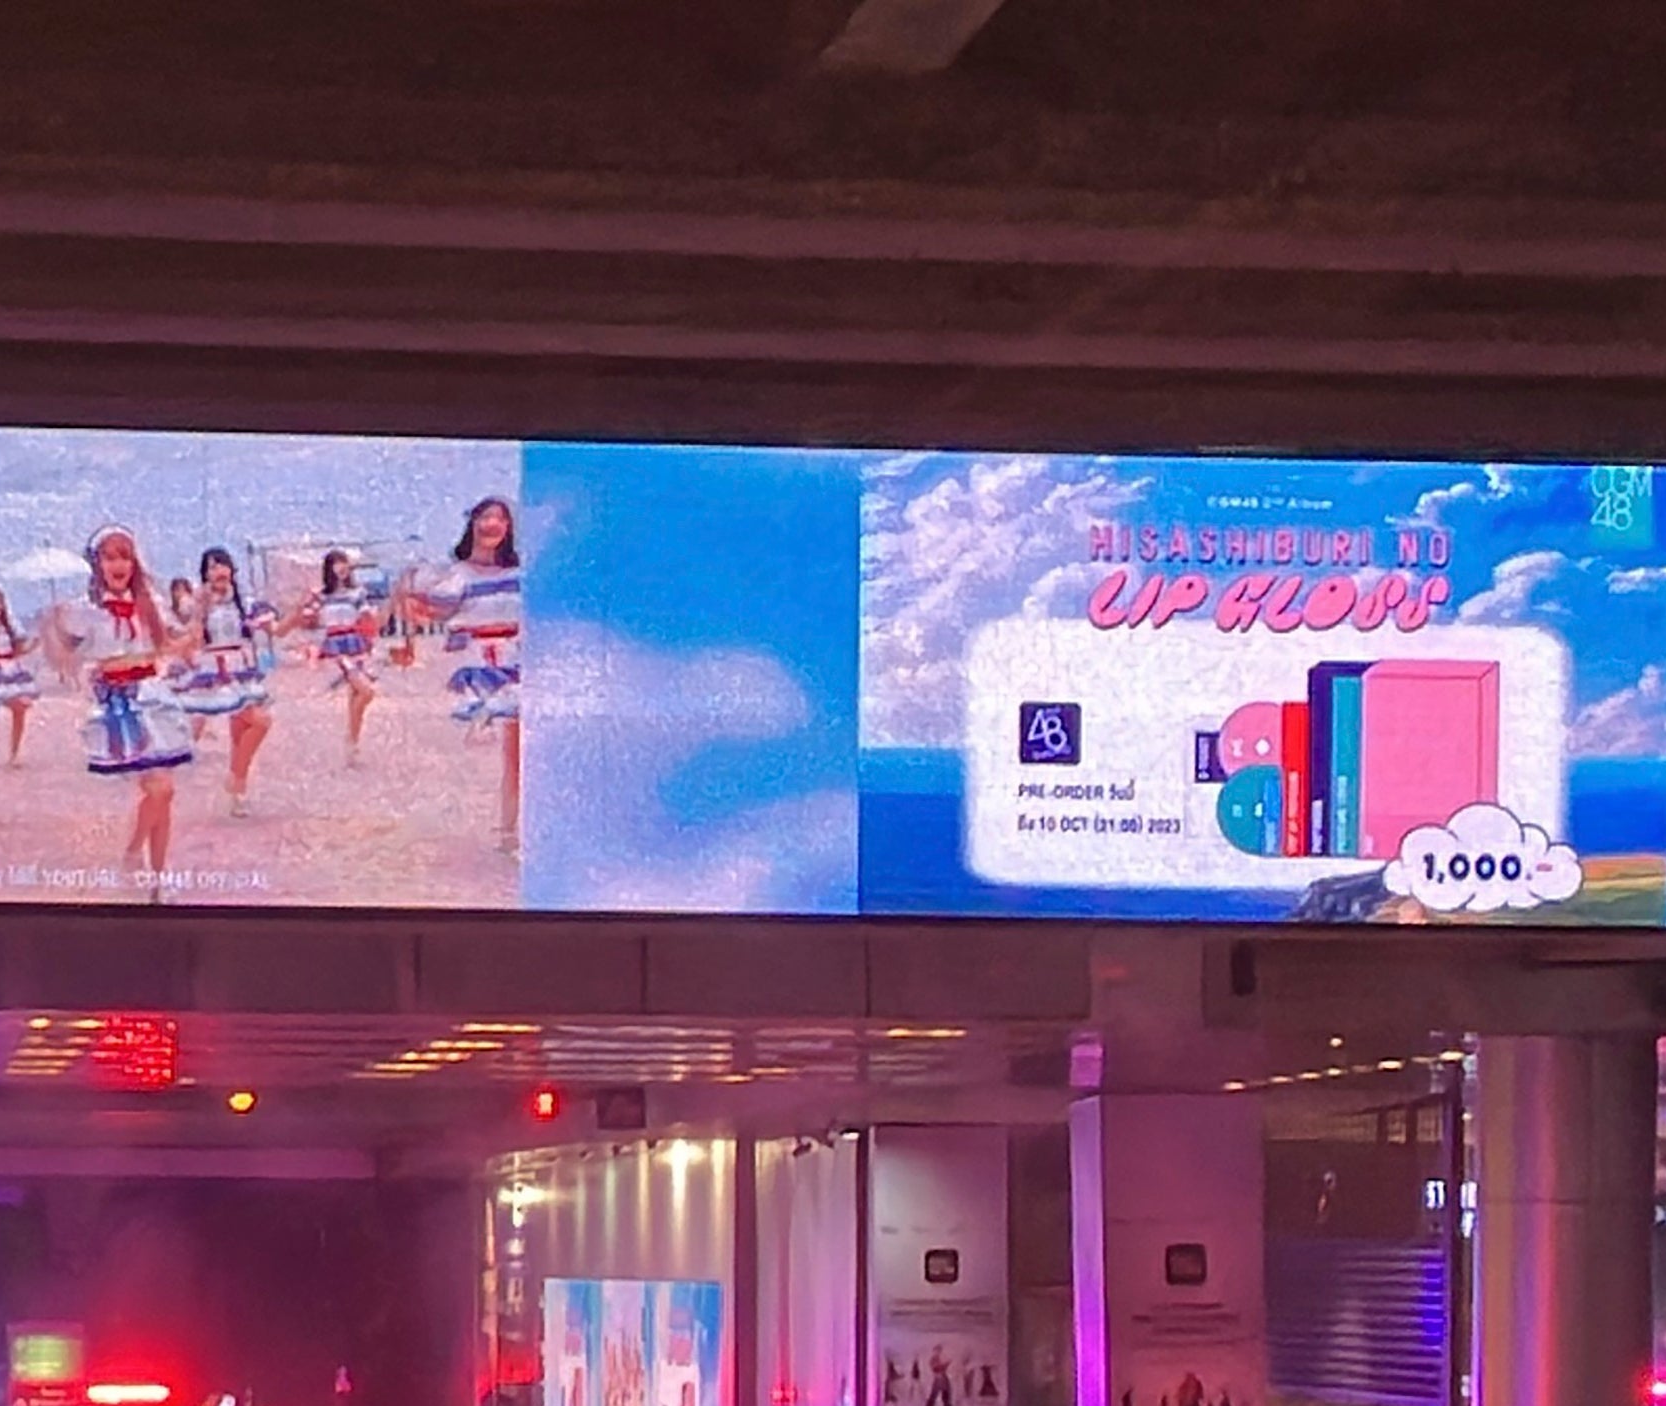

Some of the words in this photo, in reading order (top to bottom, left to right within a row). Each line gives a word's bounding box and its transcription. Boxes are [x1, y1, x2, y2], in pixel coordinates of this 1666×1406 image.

[1590, 495, 1633, 531] 48
[1089, 525, 1371, 566] HISASHIBURI
[1396, 528, 1451, 568] NO
[1087, 569, 1209, 631] LIP
[1215, 574, 1451, 634] GLOSS
[1060, 815, 1090, 833] OCT
[1148, 817, 1182, 834] 2023
